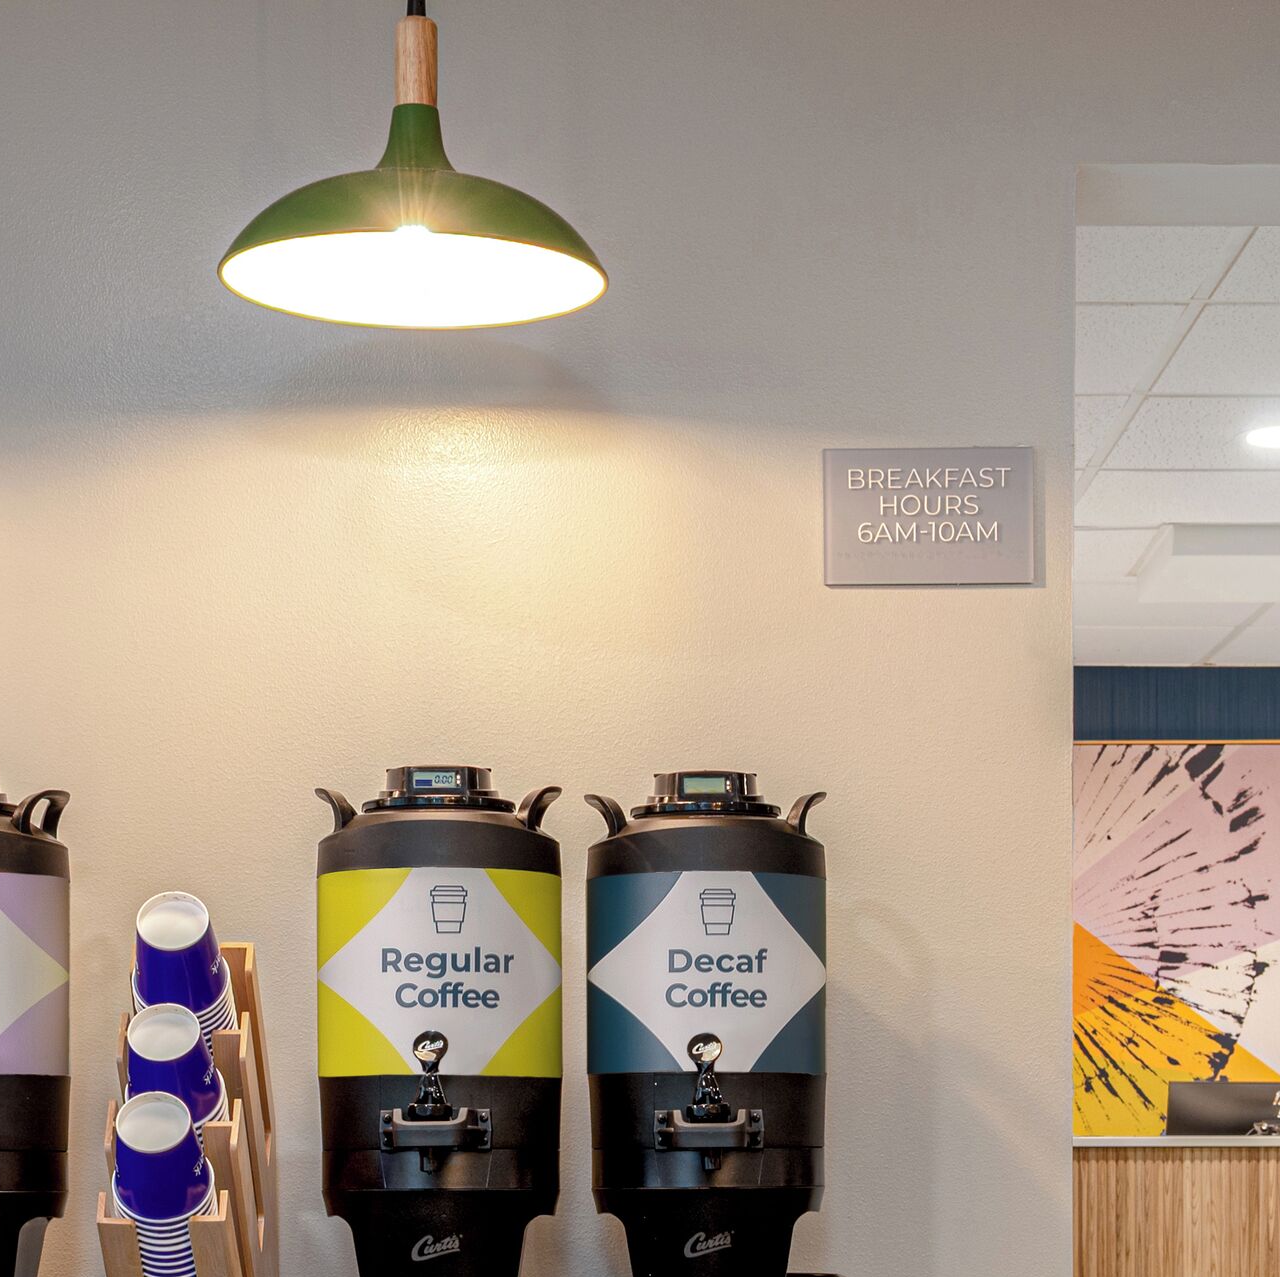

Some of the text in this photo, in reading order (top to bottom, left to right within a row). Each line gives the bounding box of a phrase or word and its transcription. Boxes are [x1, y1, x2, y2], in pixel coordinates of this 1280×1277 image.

[847, 467, 1011, 490] BREAKFAST
[879, 494, 979, 516] HOURS
[857, 521, 999, 543] 6AM-10AM
[380, 946, 515, 979] Regular
[668, 948, 768, 974] Decaf
[395, 981, 501, 1009] Coffee
[665, 981, 768, 1008] Coffee
[410, 1233, 461, 1262] Curtis
